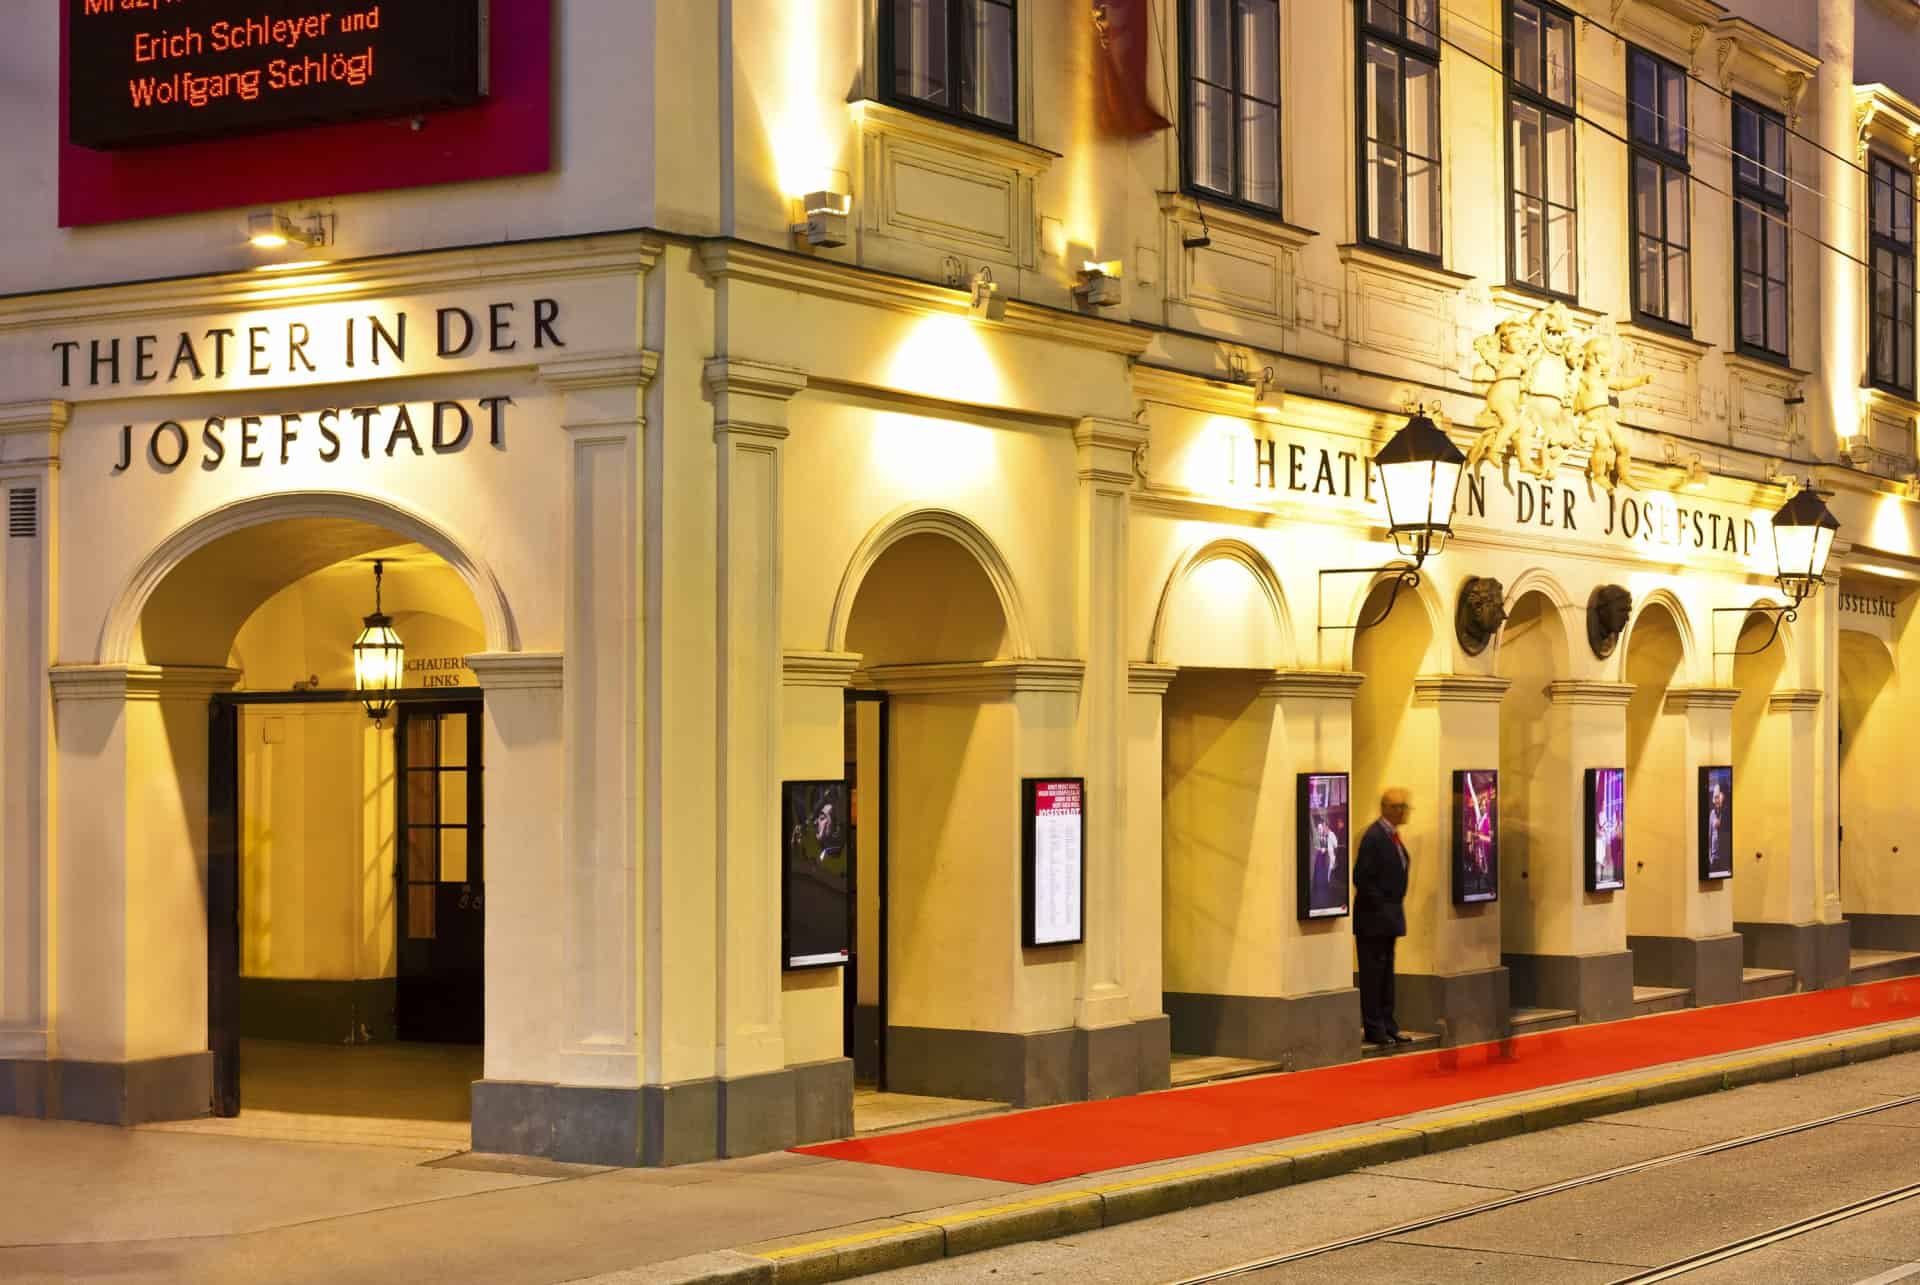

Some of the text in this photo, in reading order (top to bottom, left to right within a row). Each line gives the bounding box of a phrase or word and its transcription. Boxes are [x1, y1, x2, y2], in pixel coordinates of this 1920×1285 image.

[135, 6, 380, 62] Erich Schleyer und
[129, 46, 374, 108] Wolfgang Schlögl
[51, 298, 566, 387] THEATER IN DER
[112, 395, 514, 474] JOSEFSTADT
[1223, 433, 1377, 504] THEATE
[1516, 480, 1577, 530] DER
[1604, 494, 1757, 557] JOSEFSTAD
[423, 674, 460, 688] LINKS
